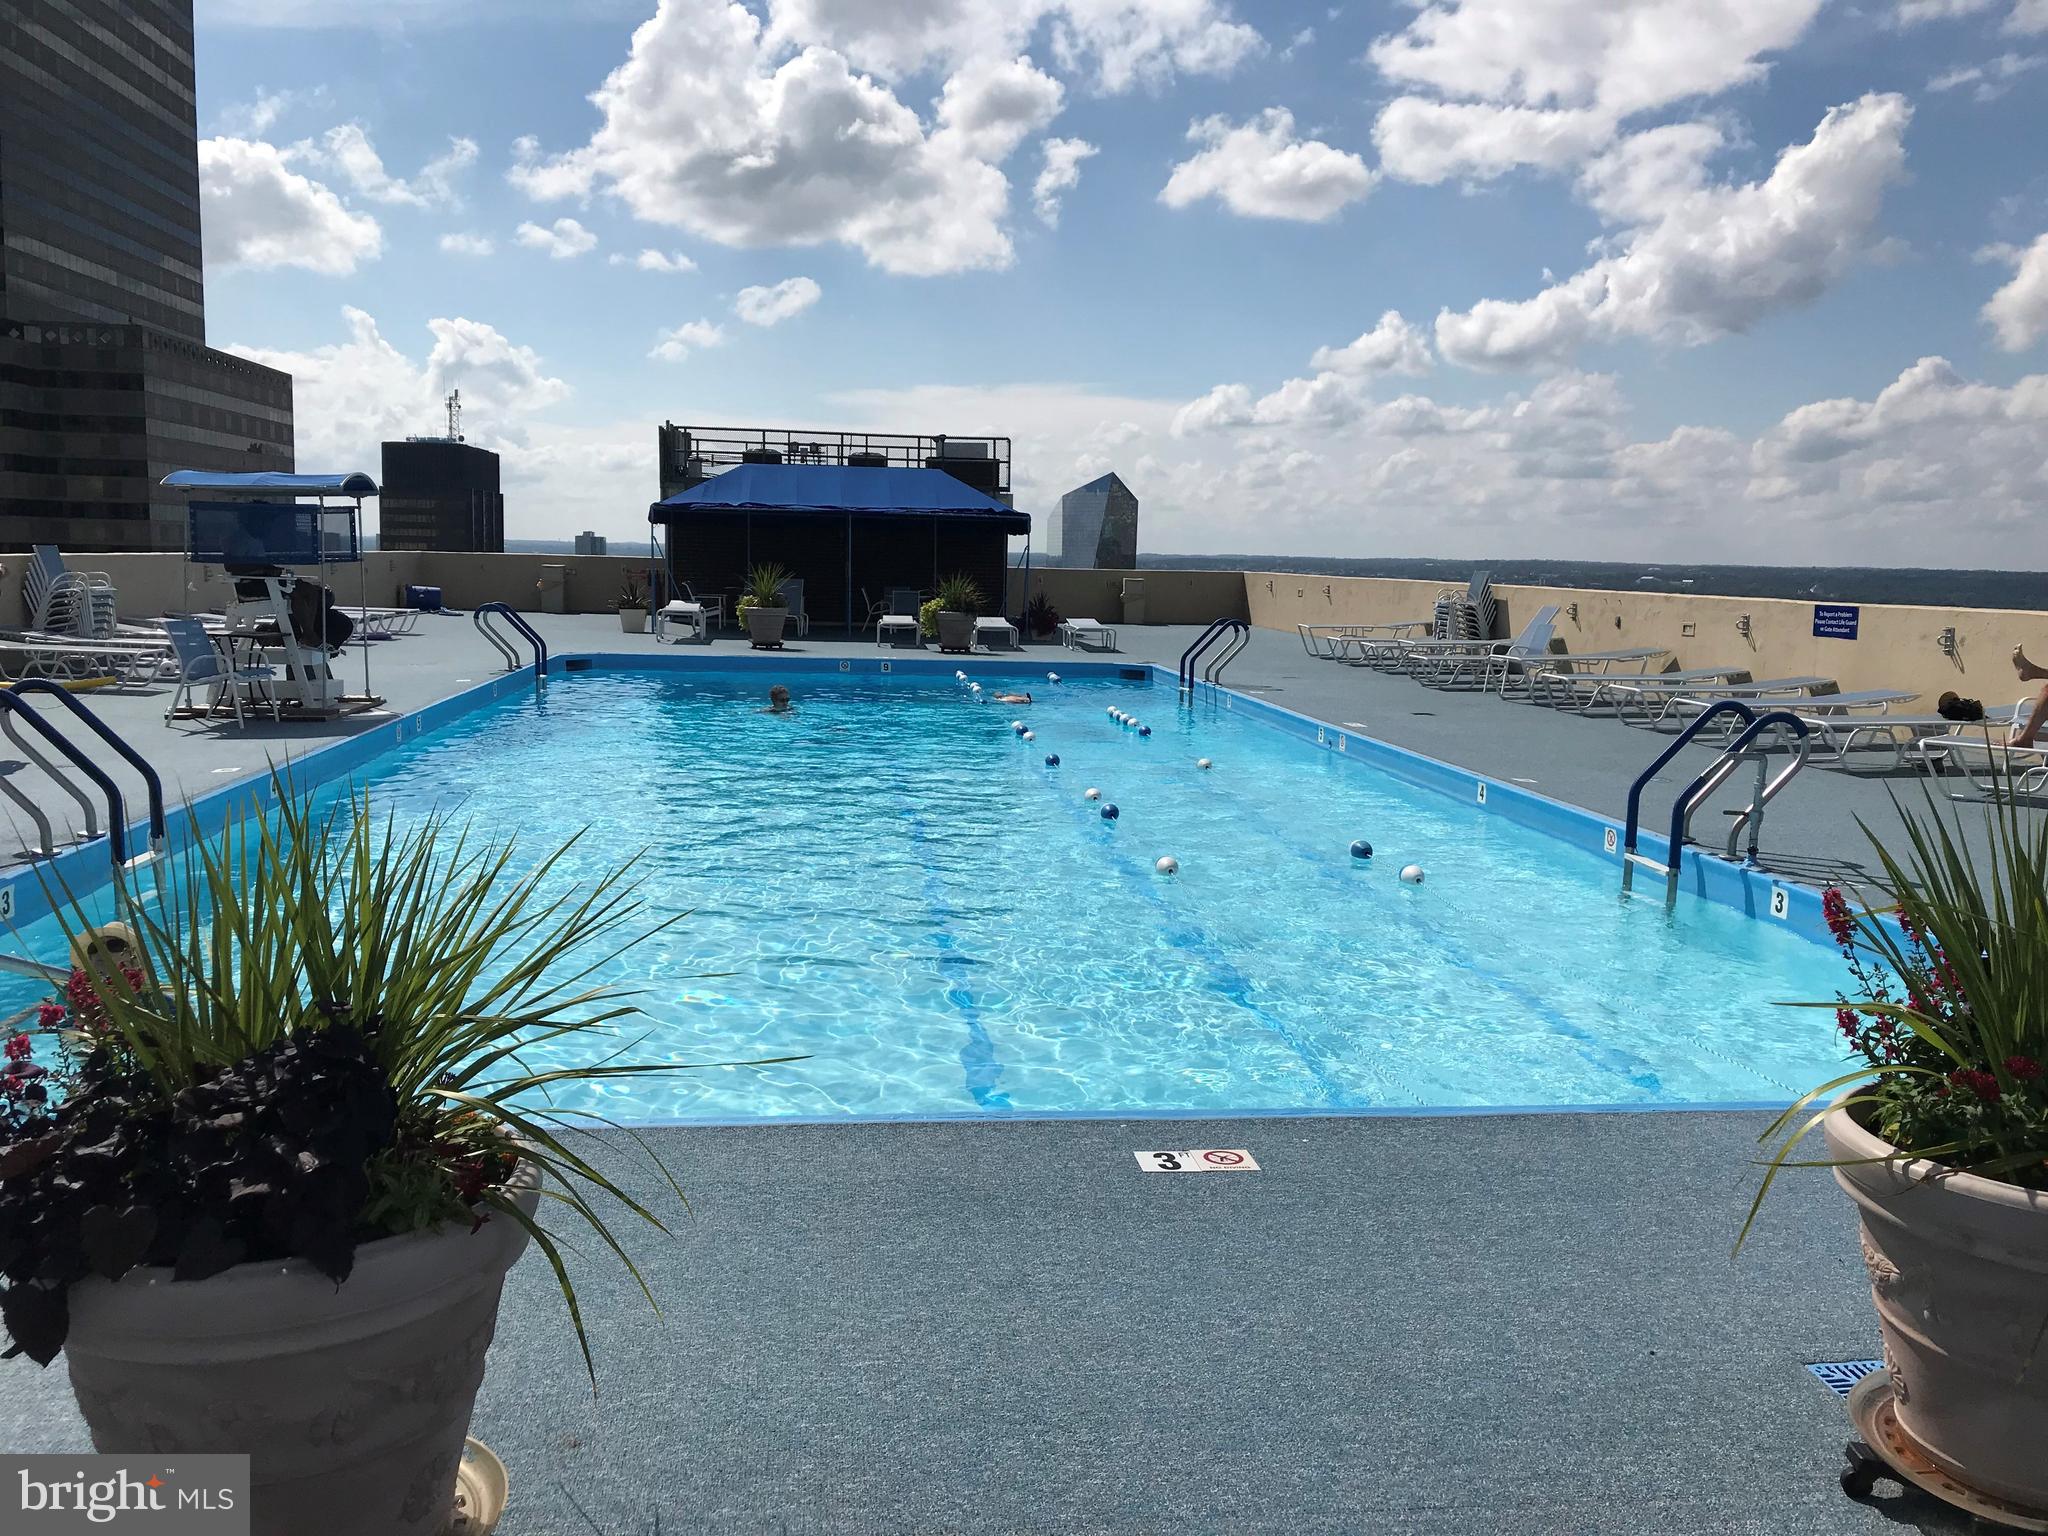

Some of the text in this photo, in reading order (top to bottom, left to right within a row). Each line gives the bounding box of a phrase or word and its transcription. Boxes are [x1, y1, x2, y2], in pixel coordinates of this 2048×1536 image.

[1479, 784, 1485, 800] 4
[2, 890, 10, 915] 3
[1775, 892, 1784, 913] 3
[1153, 1152, 1182, 1170] 3
